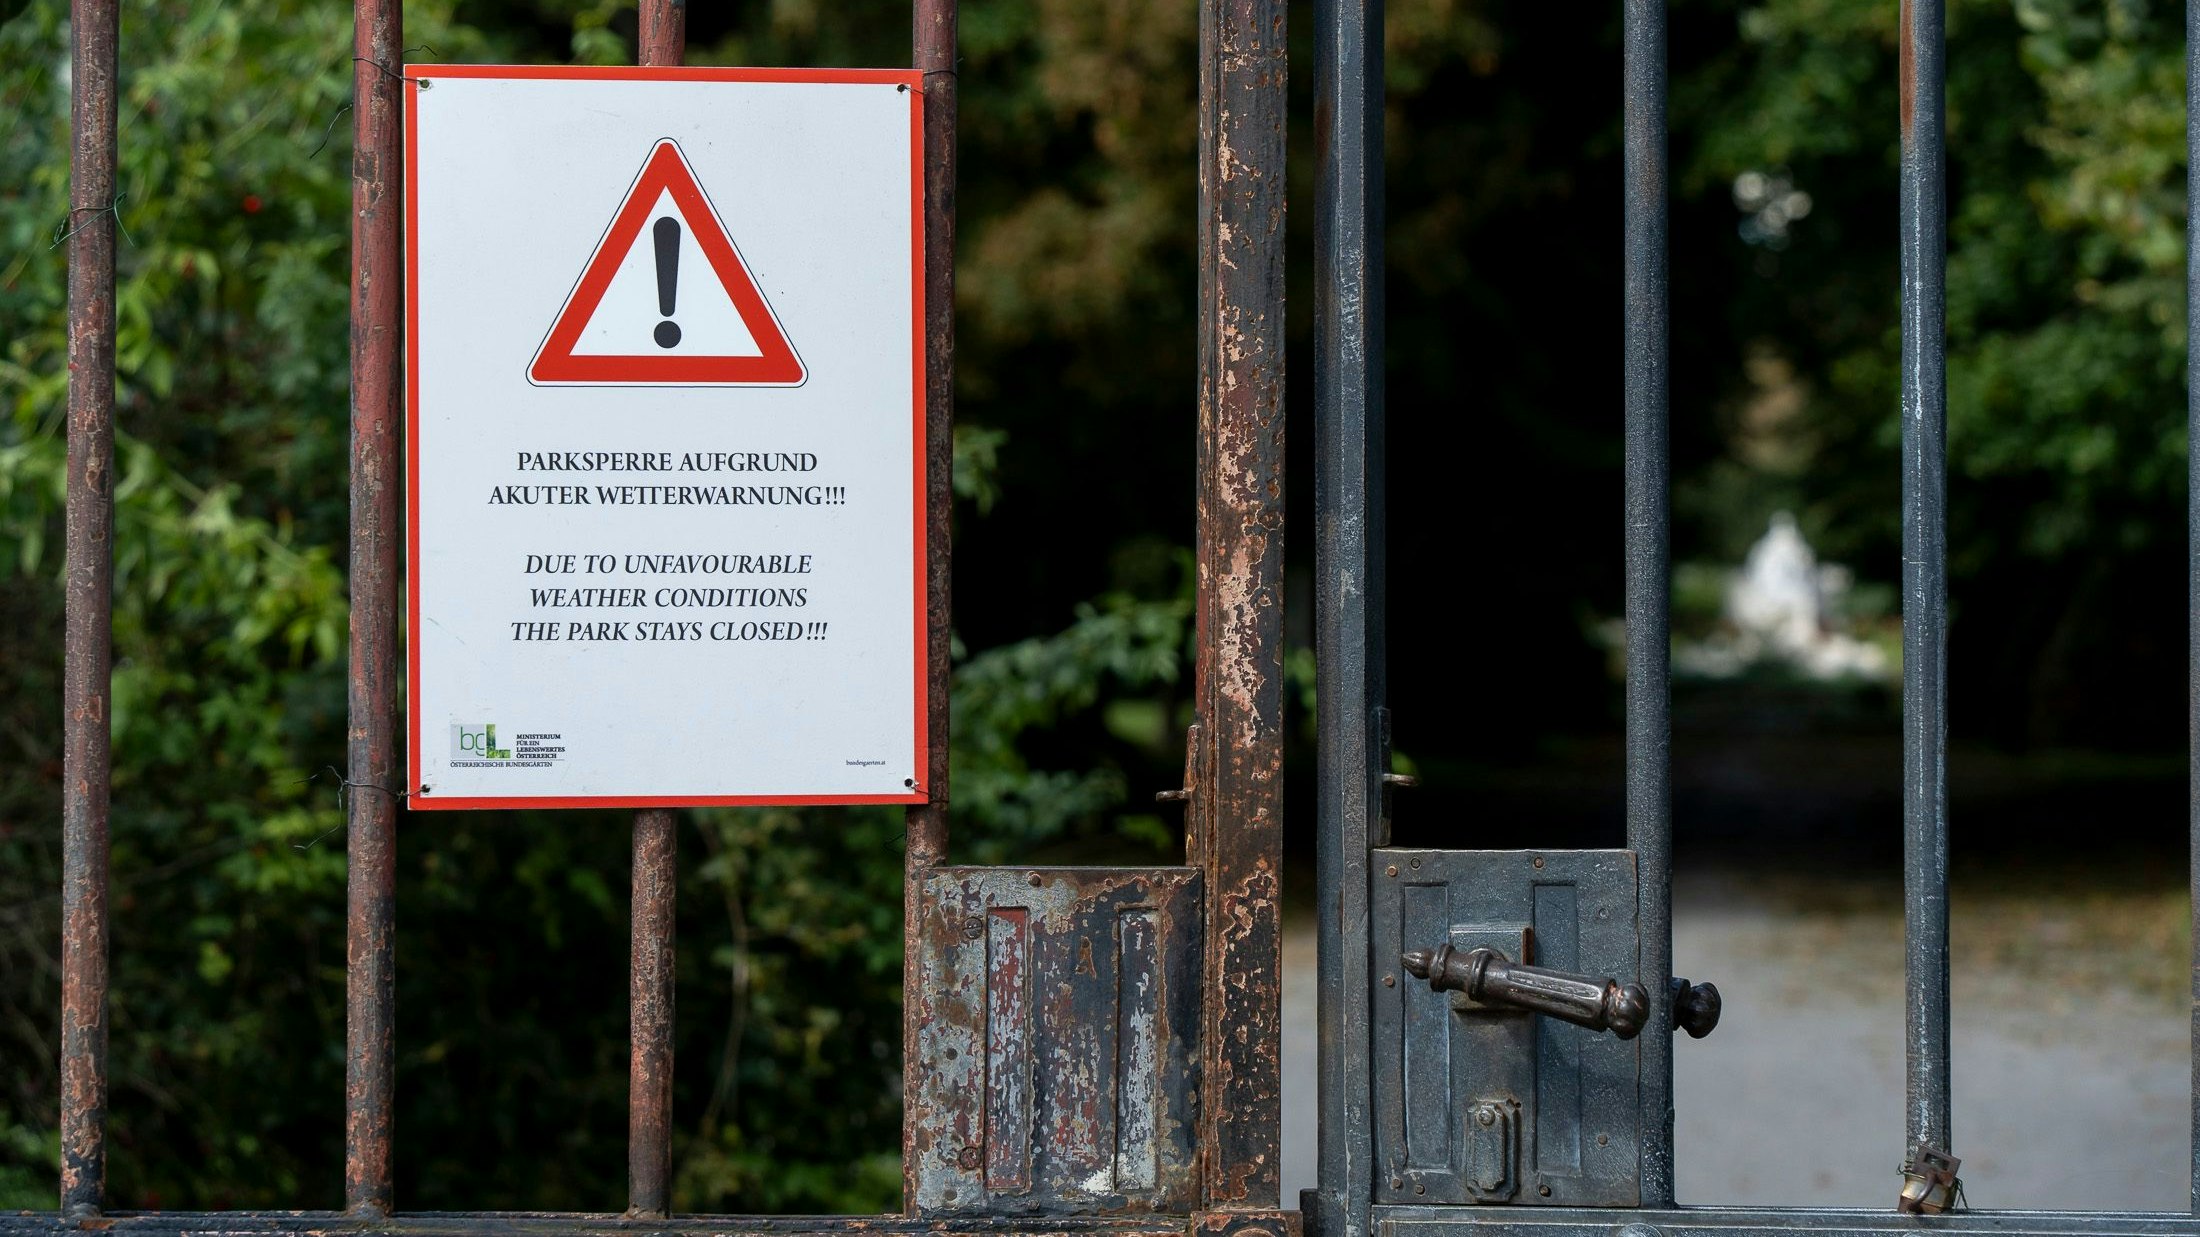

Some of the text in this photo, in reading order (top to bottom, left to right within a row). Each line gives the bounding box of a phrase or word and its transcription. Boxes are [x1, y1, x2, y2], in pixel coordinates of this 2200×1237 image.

[517, 451, 818, 472] PARKSPERRE AUFGRUND
[488, 485, 846, 506] AKUTER WETTERWARNUNG!!!
[523, 554, 812, 574] DUE TO UNFAVOURABLE
[530, 587, 808, 608] WEATHER CONDITIONS
[510, 621, 828, 641] THE PARK STAYS CLOSED!!!
